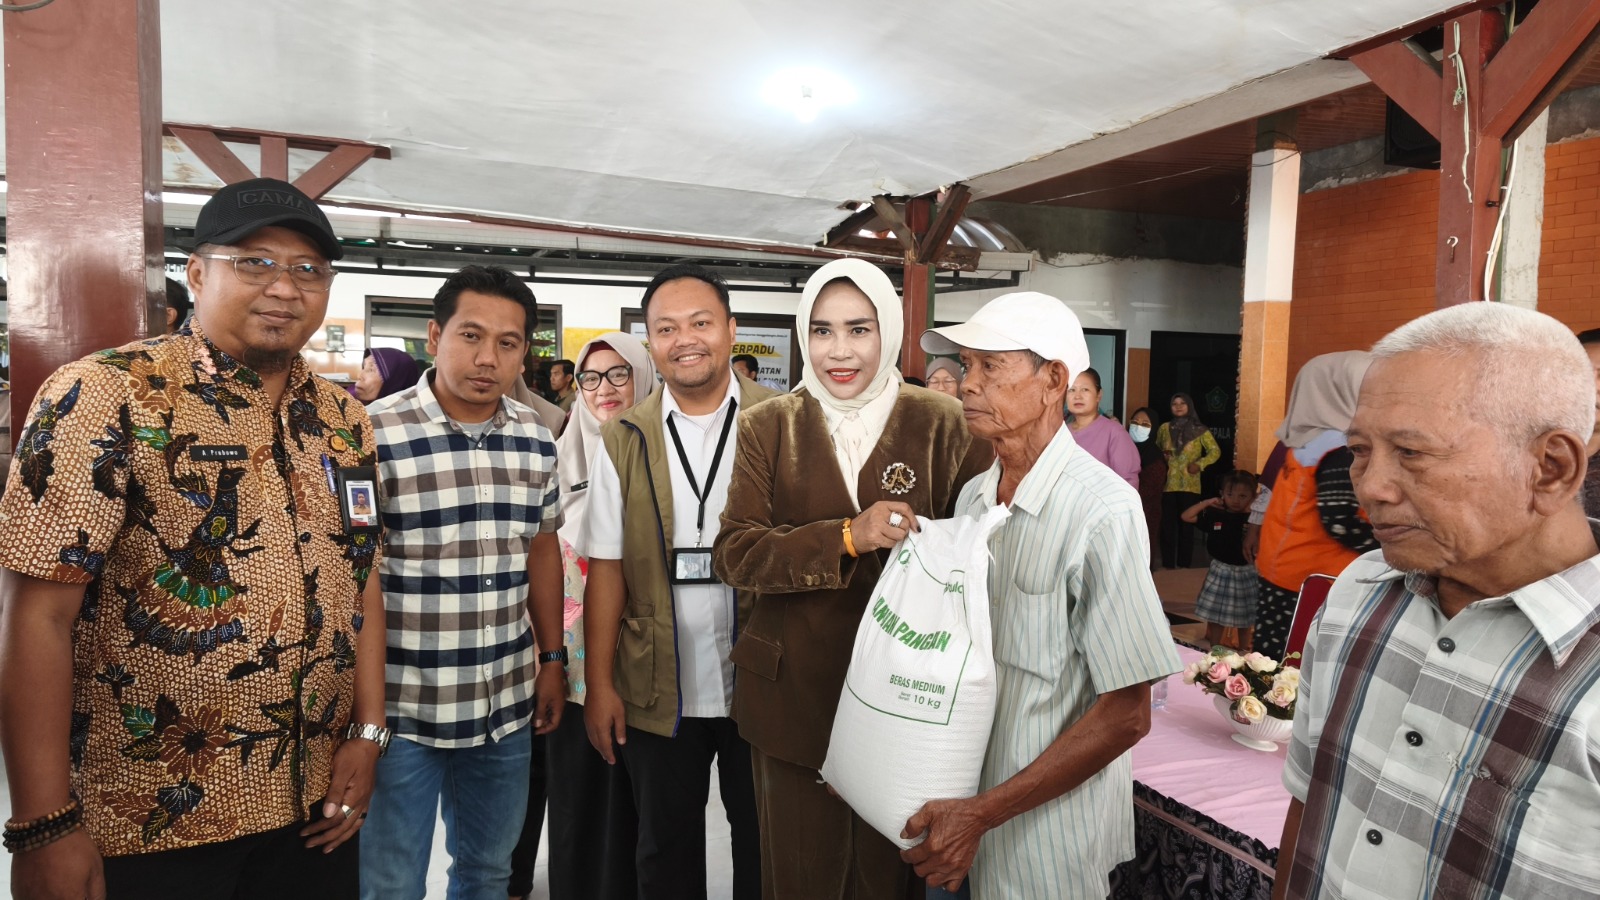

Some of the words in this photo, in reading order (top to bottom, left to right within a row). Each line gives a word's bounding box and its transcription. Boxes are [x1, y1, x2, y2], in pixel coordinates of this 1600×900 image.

[732, 344, 775, 355] ERPADU
[892, 621, 952, 653] PANGAN
[889, 674, 911, 688] BERAS
[911, 679, 946, 695] MEDIUM
[914, 694, 925, 705] 10
[927, 697, 941, 710] kg
